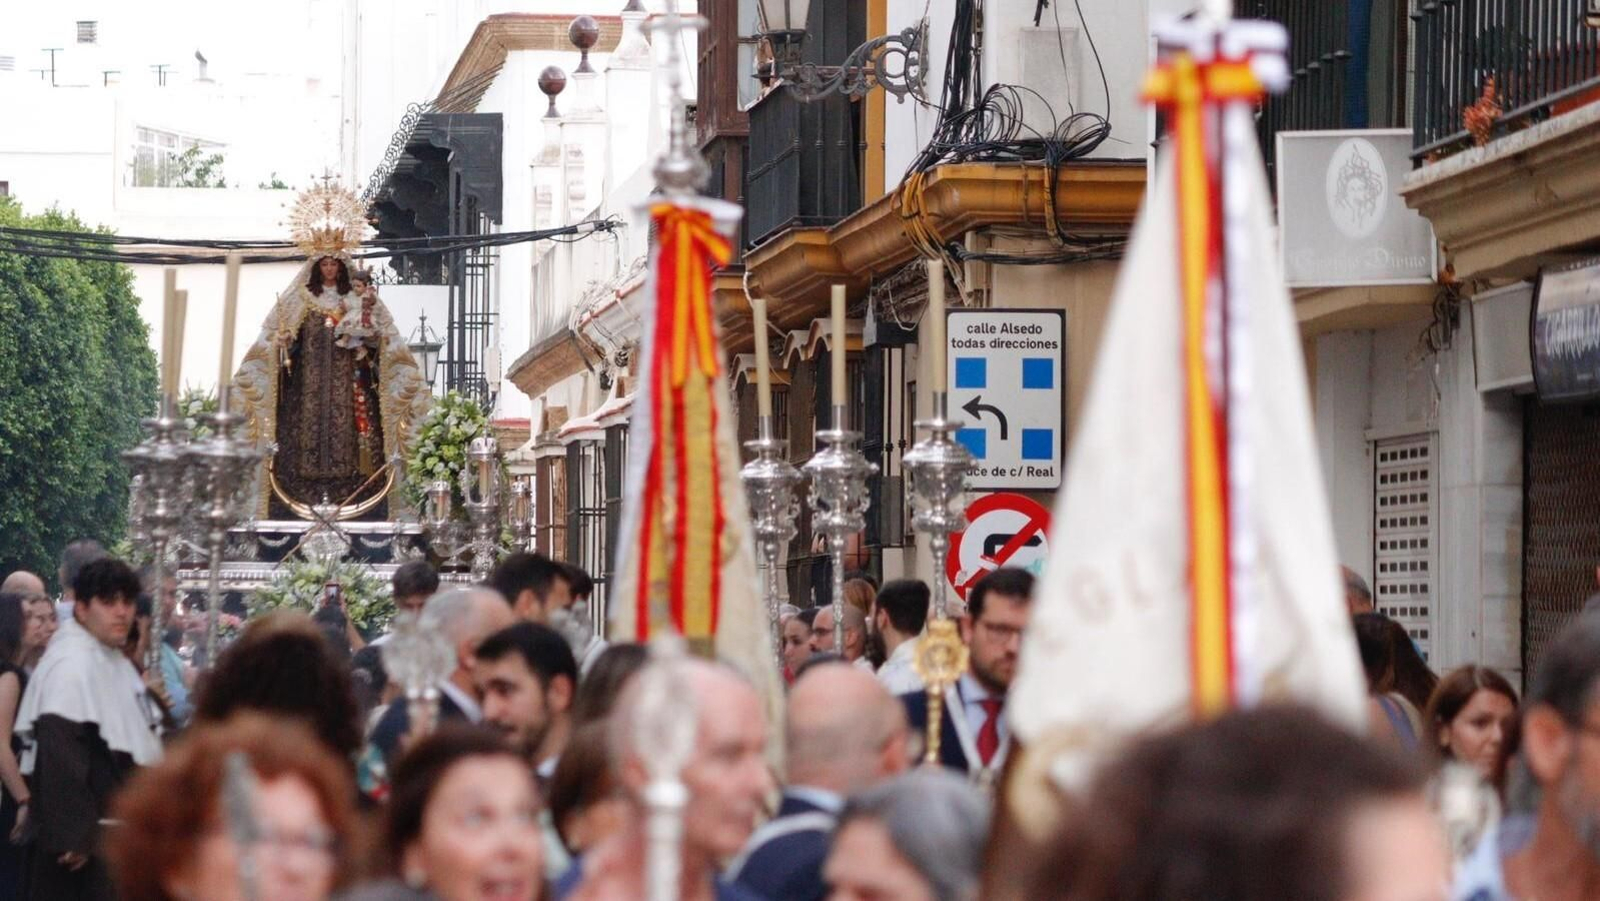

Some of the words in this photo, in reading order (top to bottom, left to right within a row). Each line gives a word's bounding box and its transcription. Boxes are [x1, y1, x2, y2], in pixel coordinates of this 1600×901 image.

[967, 323, 996, 335] calle
[1000, 323, 1043, 335] Alsedo
[951, 337, 986, 349] todas
[989, 338, 1058, 350] direcciones
[965, 468, 988, 477] uce
[991, 466, 1006, 477] de
[1010, 466, 1024, 477] c/
[1026, 466, 1054, 477] Real
